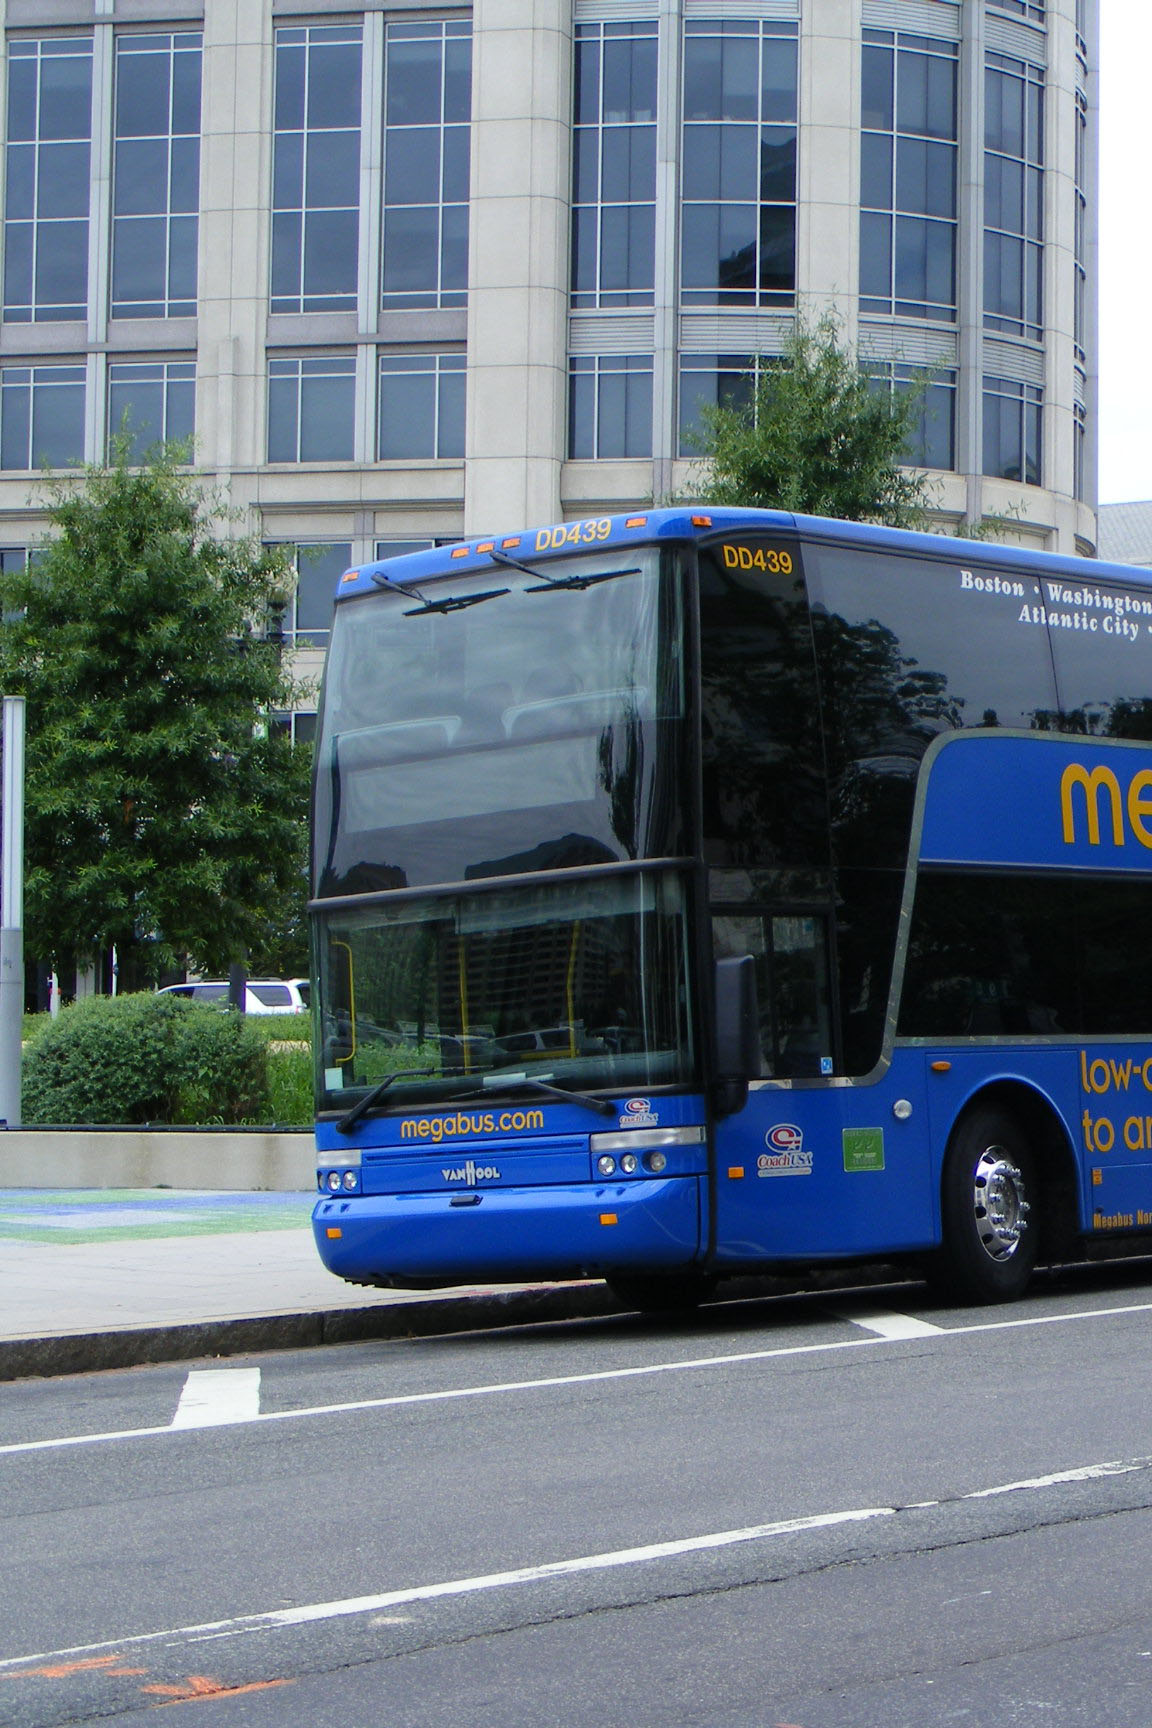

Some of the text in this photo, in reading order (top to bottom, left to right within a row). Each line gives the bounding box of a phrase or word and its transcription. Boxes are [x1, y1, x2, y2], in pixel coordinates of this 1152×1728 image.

[534, 519, 611, 551] DD439
[723, 545, 793, 575] DD439
[960, 570, 1024, 598] Boston
[1018, 604, 1098, 632] Atlantic
[1102, 616, 1139, 641] City
[401, 1109, 544, 1144] megabus.com
[1082, 1109, 1116, 1153] to
[1093, 1212, 1133, 1230] Megabus
